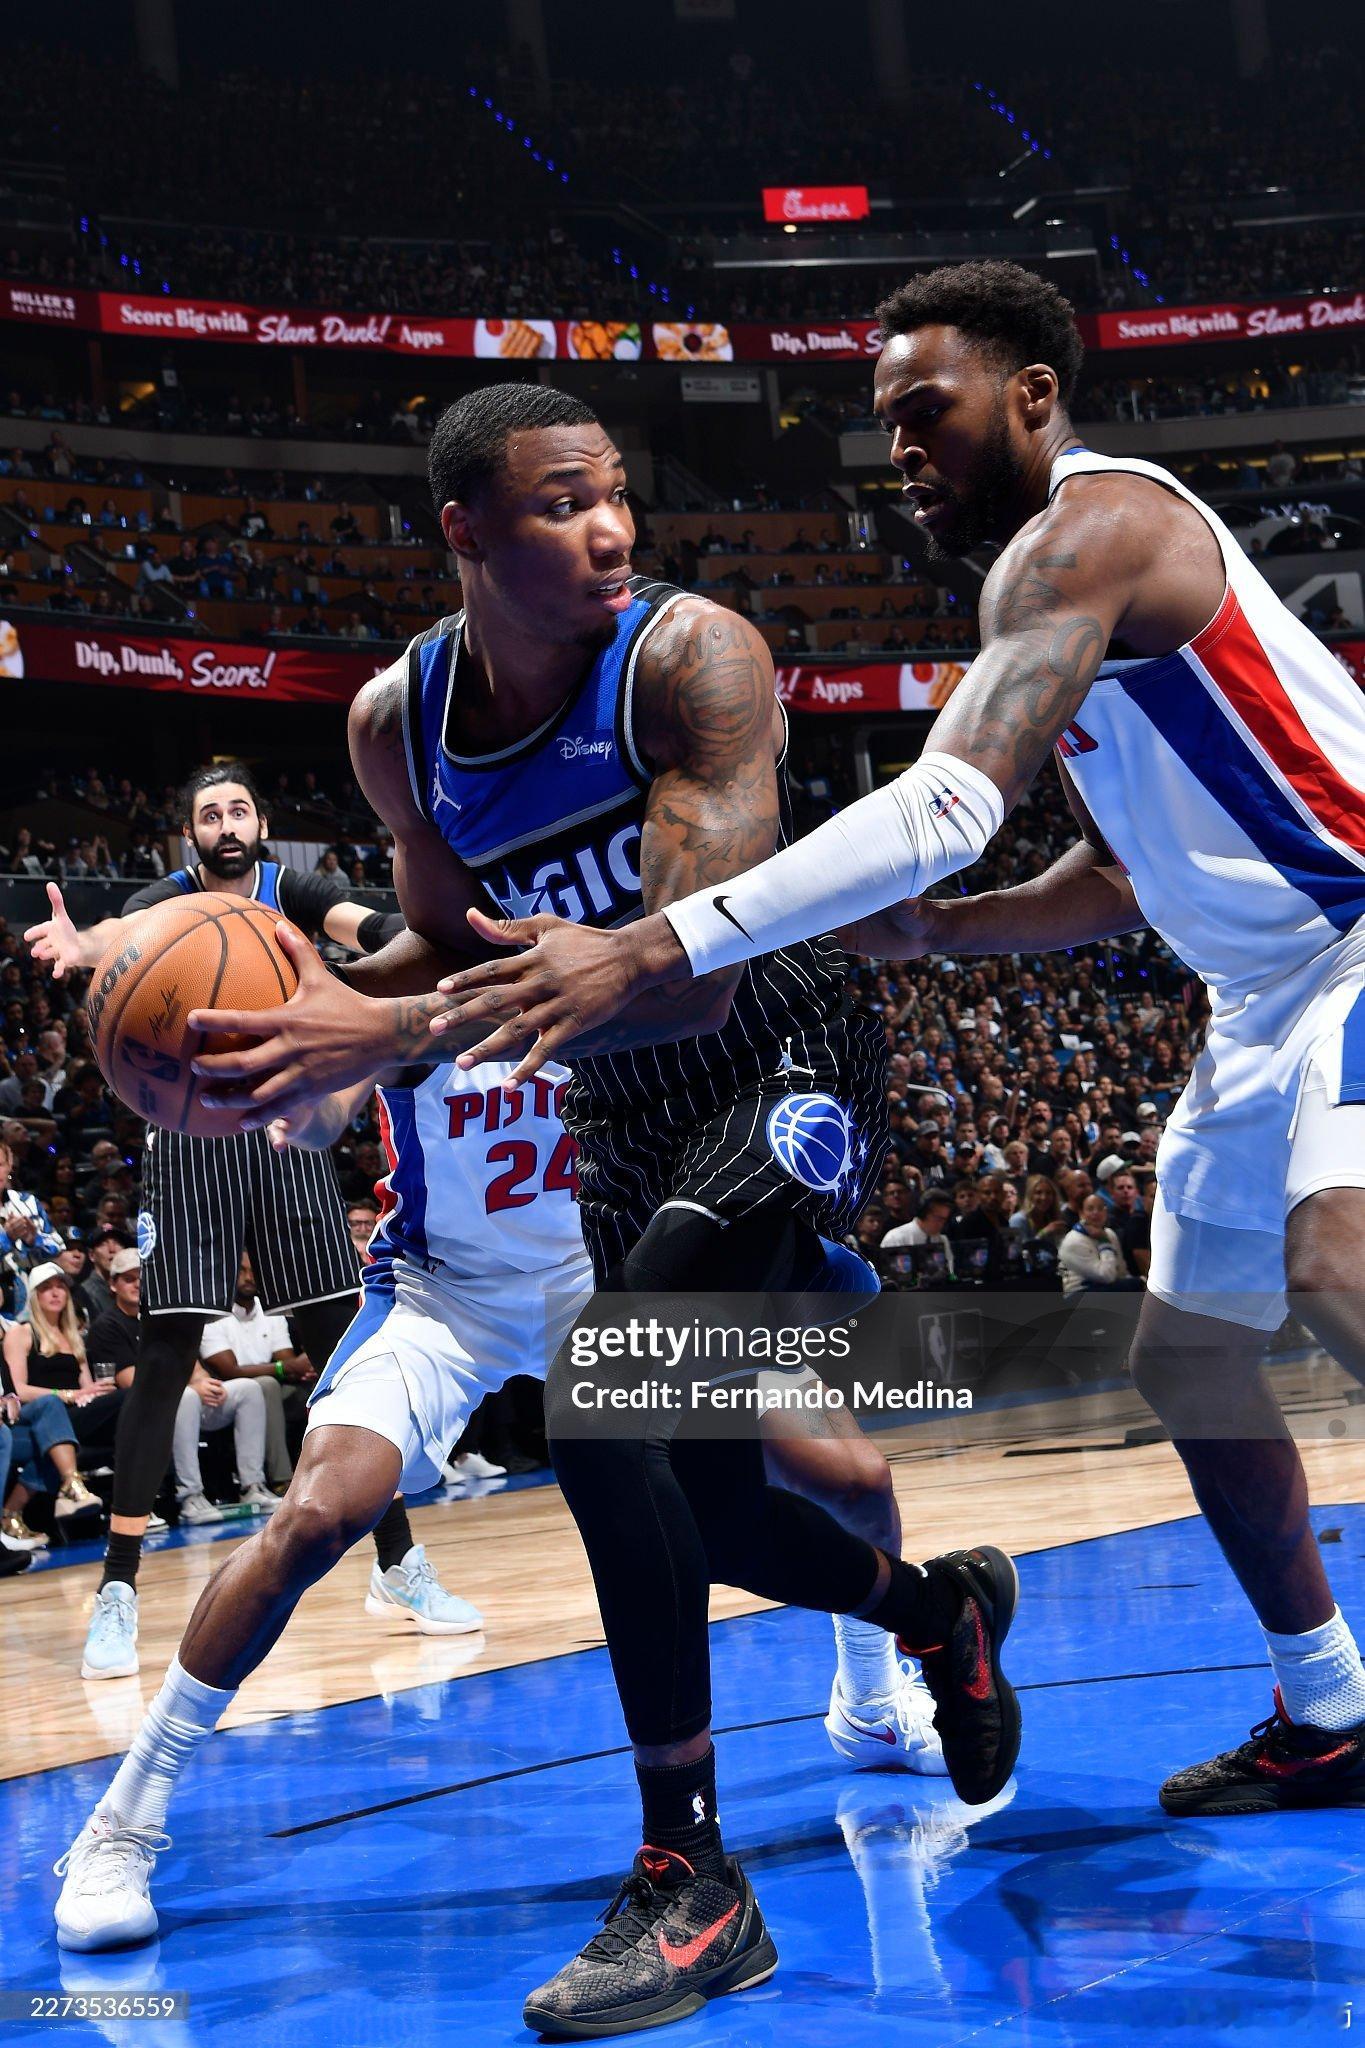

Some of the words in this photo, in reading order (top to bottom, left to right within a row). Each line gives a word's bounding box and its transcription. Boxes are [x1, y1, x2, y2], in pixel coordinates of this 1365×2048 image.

[120, 303, 174, 327] Score
[175, 308, 207, 333] Big
[207, 310, 249, 332] with
[257, 315, 317, 343] Slam
[321, 314, 392, 343] Dunk!
[400, 324, 444, 349] Apps
[770, 332, 807, 354] Dip,
[1118, 318, 1170, 339] Score
[1170, 316, 1200, 337] Big
[1200, 311, 1239, 332] with
[1247, 308, 1304, 336] Slam
[75, 641, 121, 677] Dip,
[121, 646, 184, 682] Dunk,
[190, 651, 276, 688] Score!
[811, 676, 864, 704] Apps
[443, 1072, 570, 1140] PIST
[484, 1132, 581, 1216] 24
